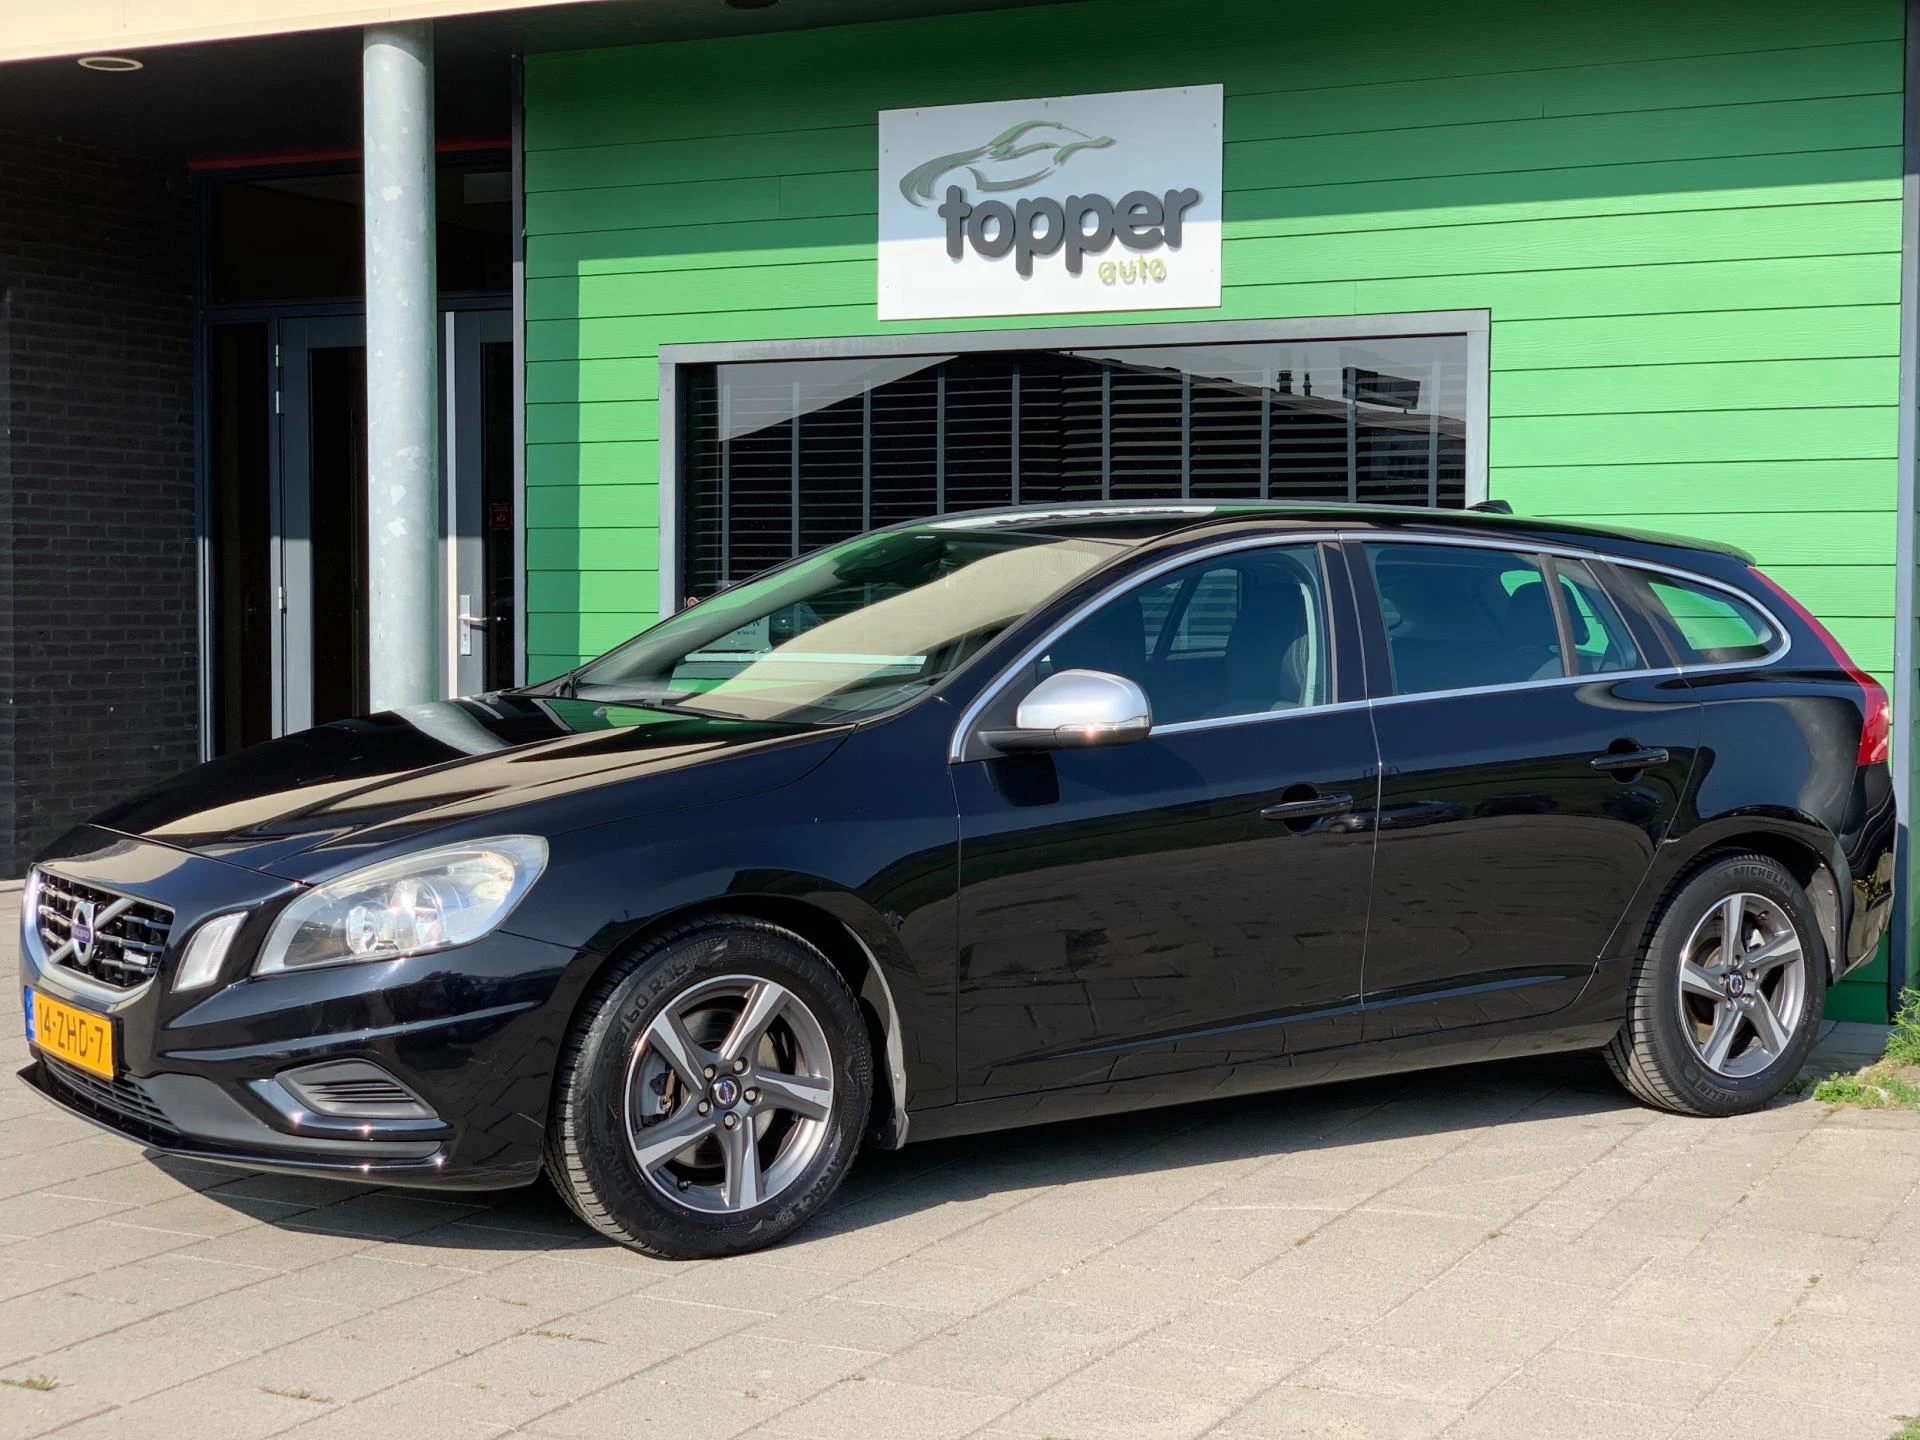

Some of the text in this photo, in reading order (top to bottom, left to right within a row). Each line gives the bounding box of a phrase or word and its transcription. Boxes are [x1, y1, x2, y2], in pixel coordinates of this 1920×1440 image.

[938, 185, 1199, 275] topper
[1098, 255, 1165, 284] auto
[1734, 866, 1792, 893] MICHELIN
[38, 1002, 104, 1064] 14-ZHD-7
